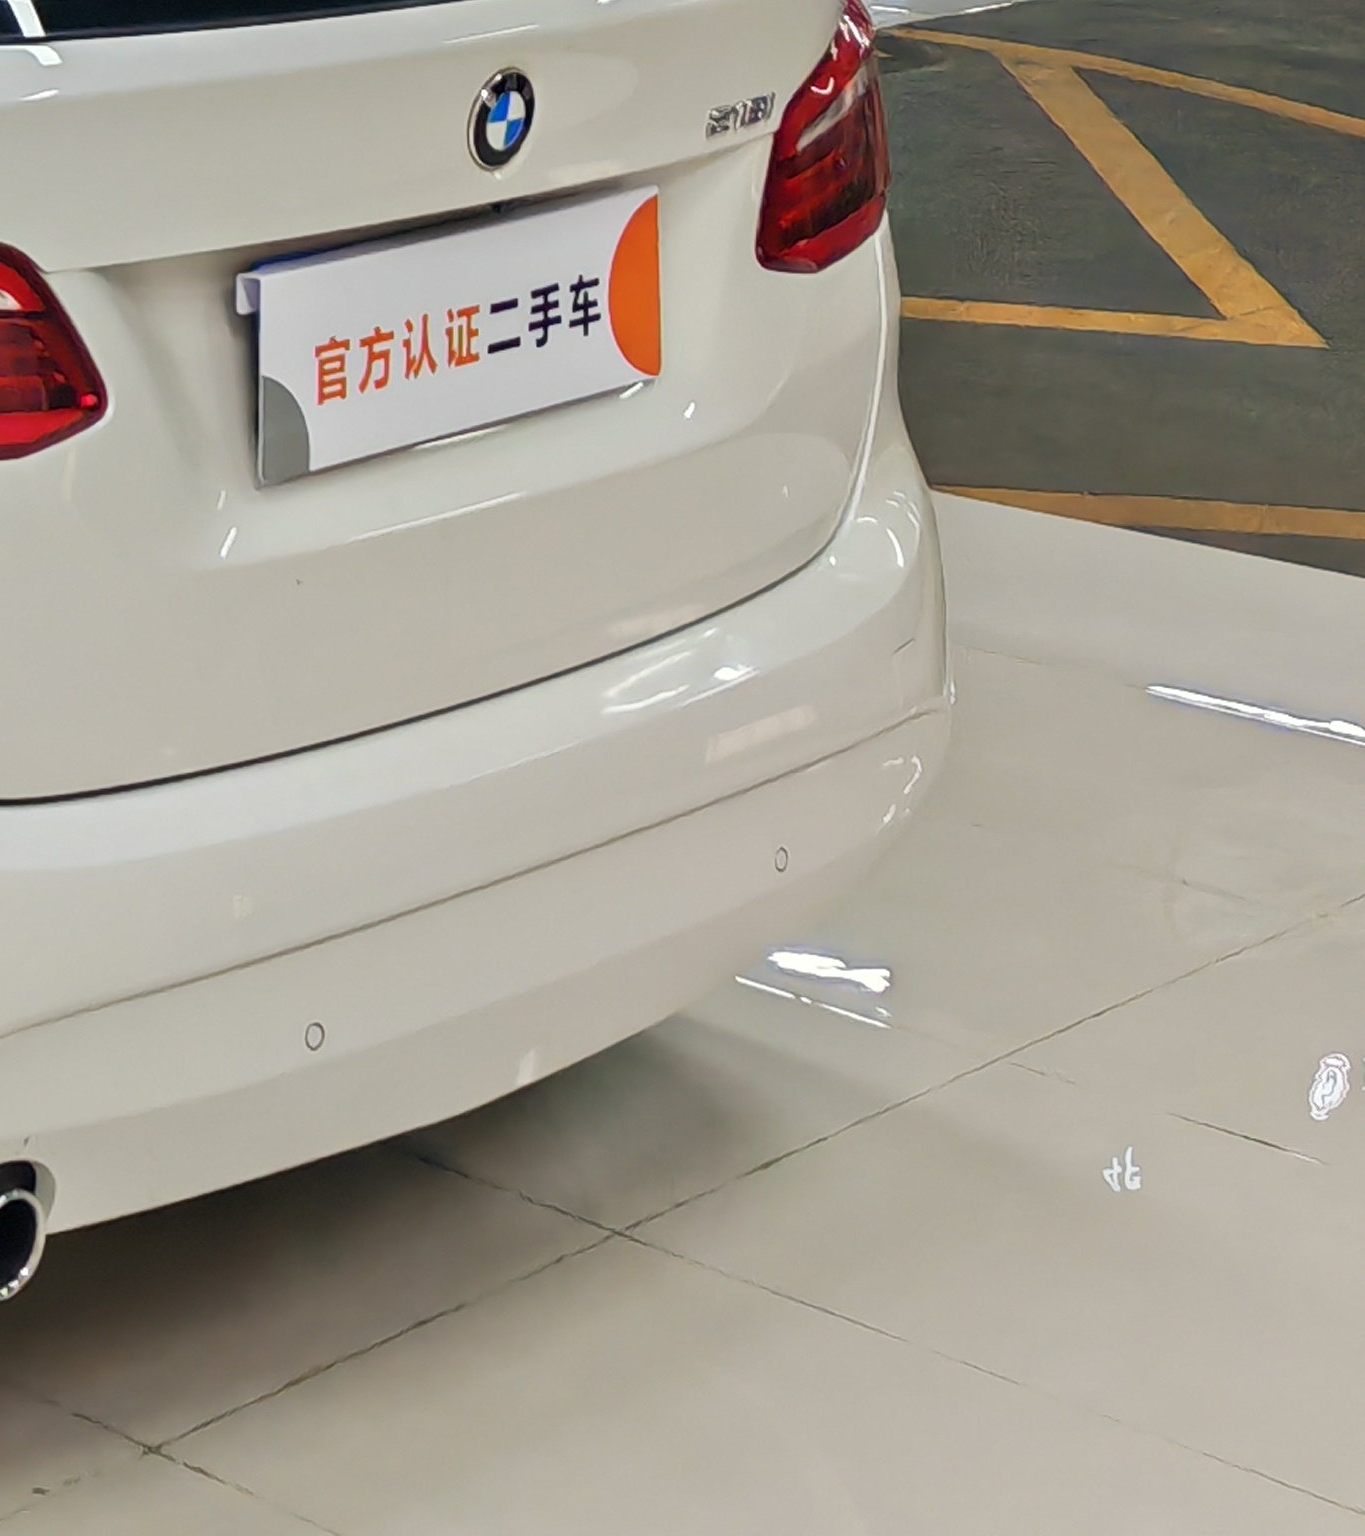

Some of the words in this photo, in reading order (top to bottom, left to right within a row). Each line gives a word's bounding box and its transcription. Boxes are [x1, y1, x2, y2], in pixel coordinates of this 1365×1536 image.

[314, 274, 601, 406] 官方认证二手车
